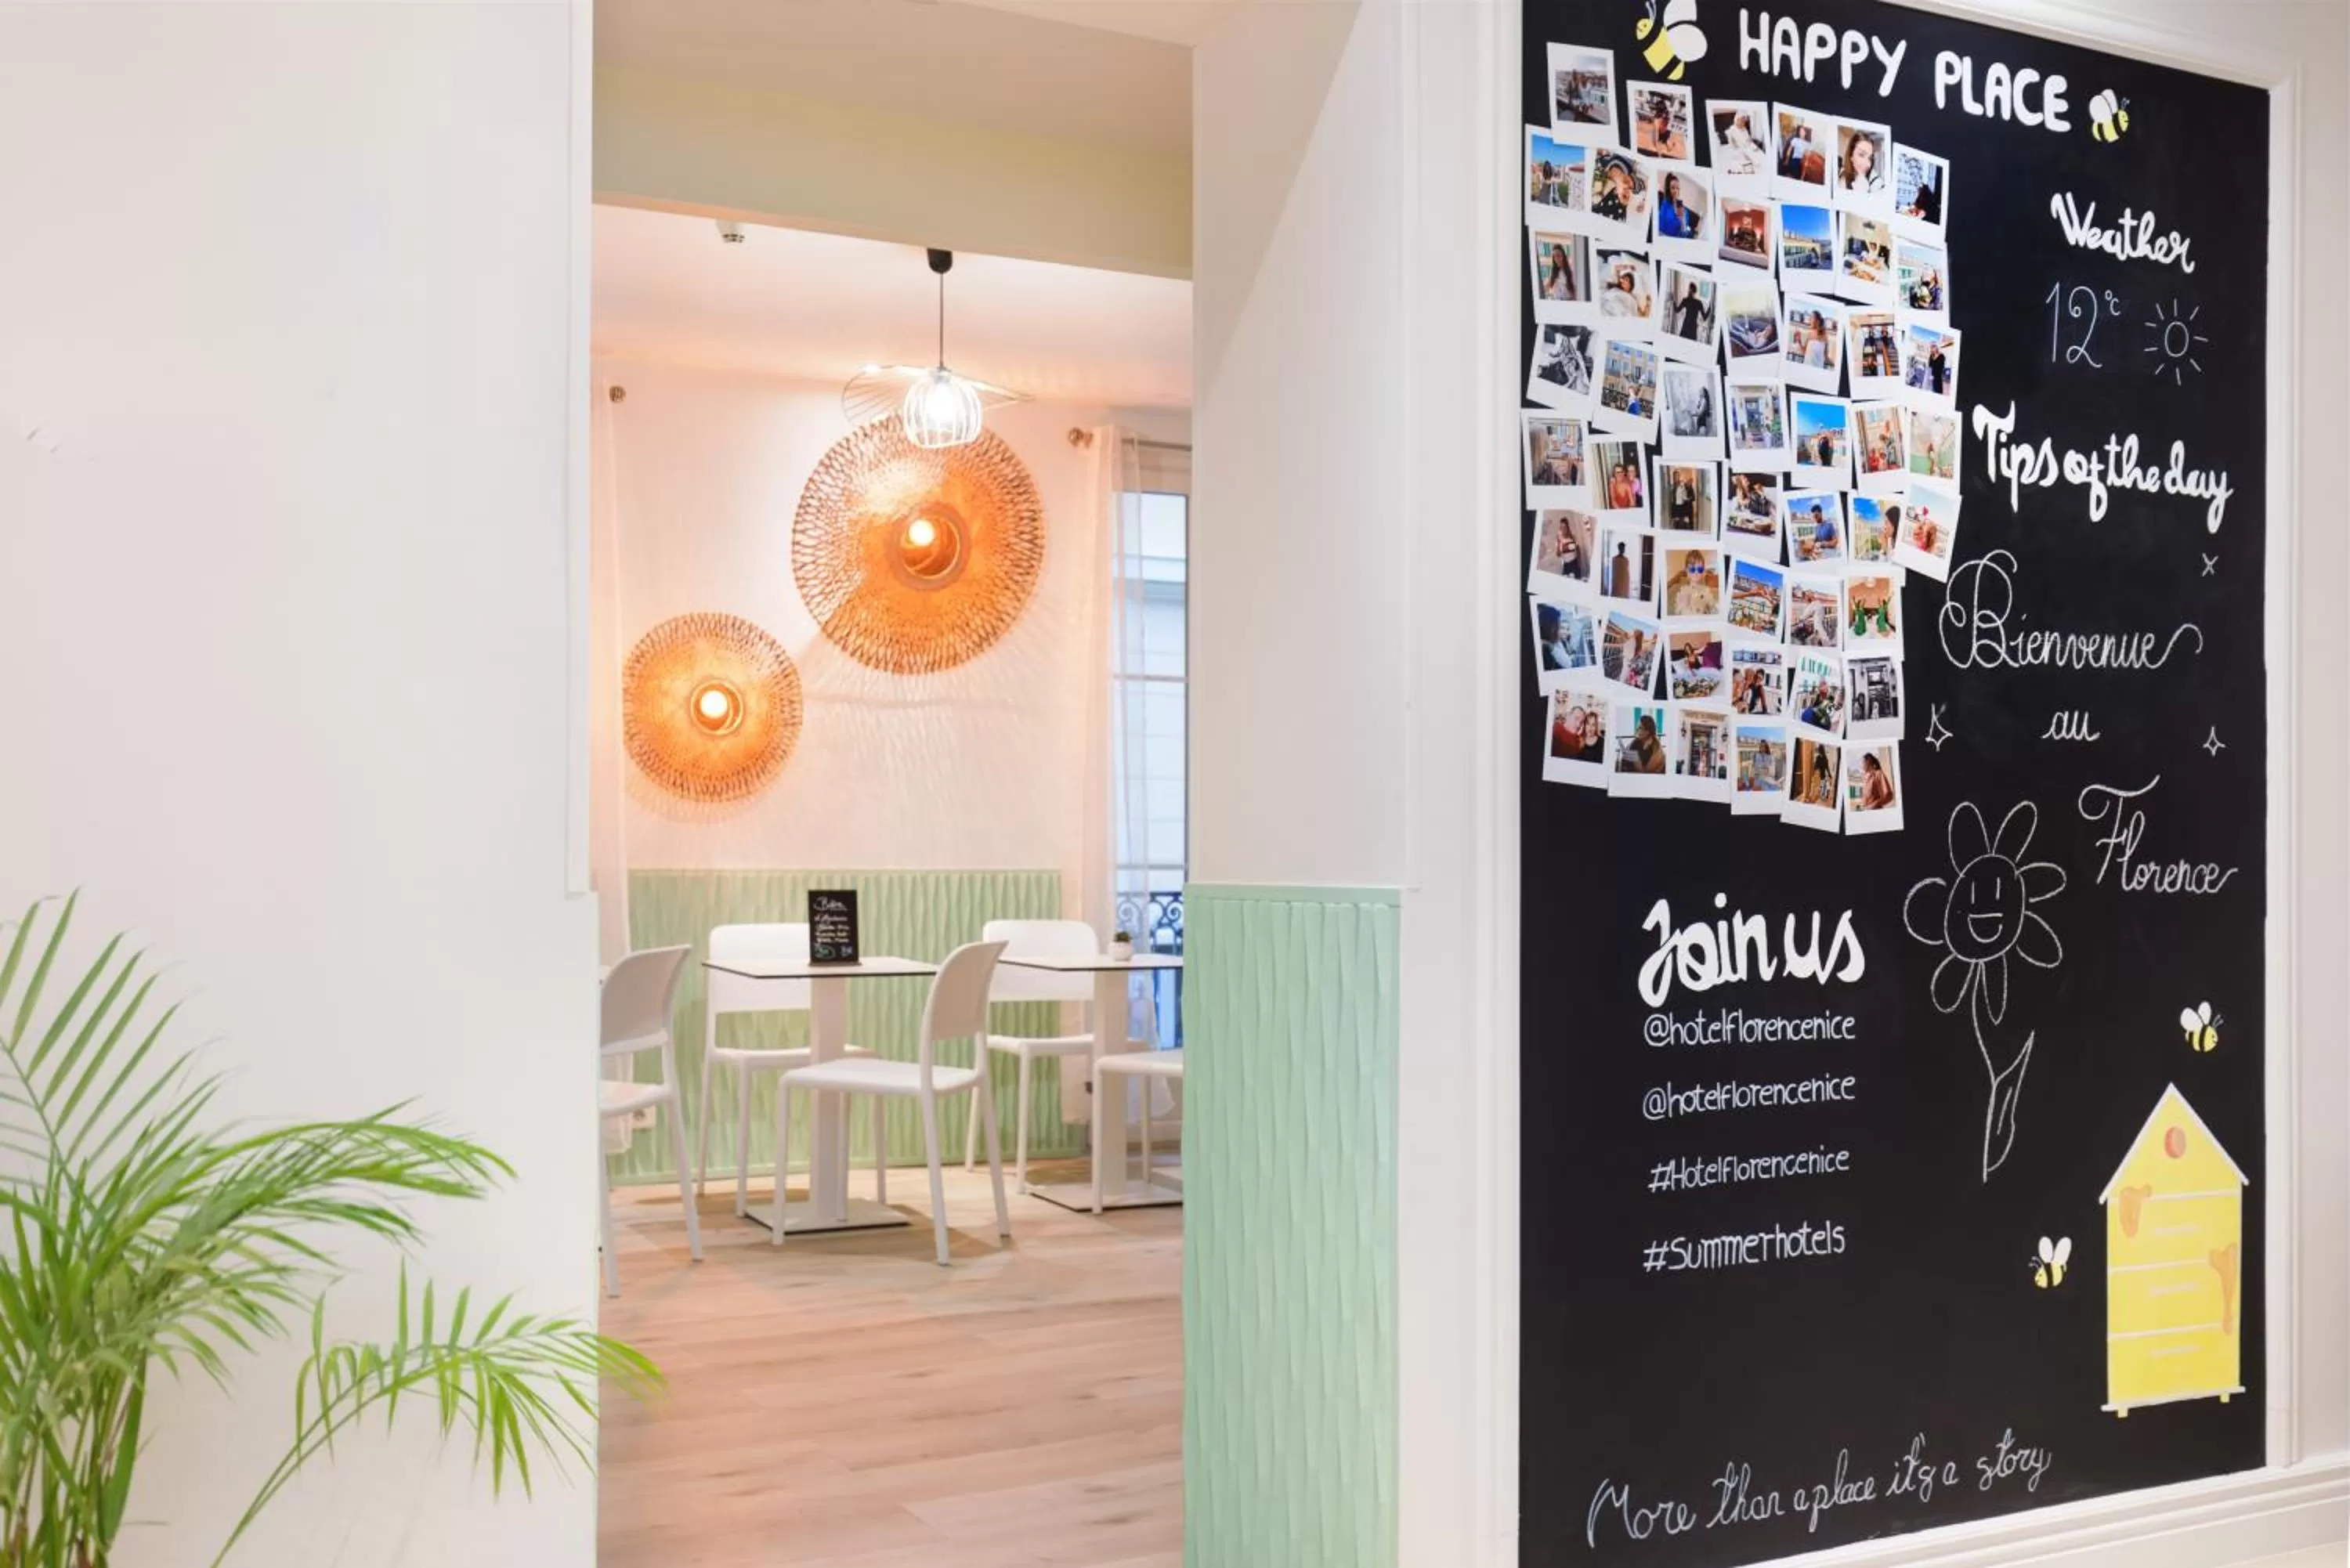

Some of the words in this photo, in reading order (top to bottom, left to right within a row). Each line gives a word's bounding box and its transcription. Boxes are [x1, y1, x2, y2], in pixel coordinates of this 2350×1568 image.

[1739, 7, 1907, 98] HAPPY
[1934, 49, 2072, 132] PLACE
[2050, 191, 2196, 274] Weather
[1972, 400, 2059, 514] Tips
[2063, 449, 2107, 522] of
[2102, 432, 2161, 495] the
[2163, 439, 2235, 534] day
[1939, 549, 2204, 670] Bienvenue
[2041, 710, 2101, 742] au
[2077, 775, 2239, 894] Florence
[1637, 892, 1778, 1008] Join
[1781, 909, 1866, 985] us
[1643, 1007, 1856, 1047] @hotelflorencenice
[1643, 1071, 1856, 1121] @hotelflorencenice
[1643, 1219, 1846, 1273] #Summerhotels
[1586, 1478, 1697, 1548] More
[1705, 1461, 1786, 1529] than
[1809, 1448, 1878, 1534] place
[1942, 1461, 1960, 1486] a
[1976, 1428, 2052, 1492] story
